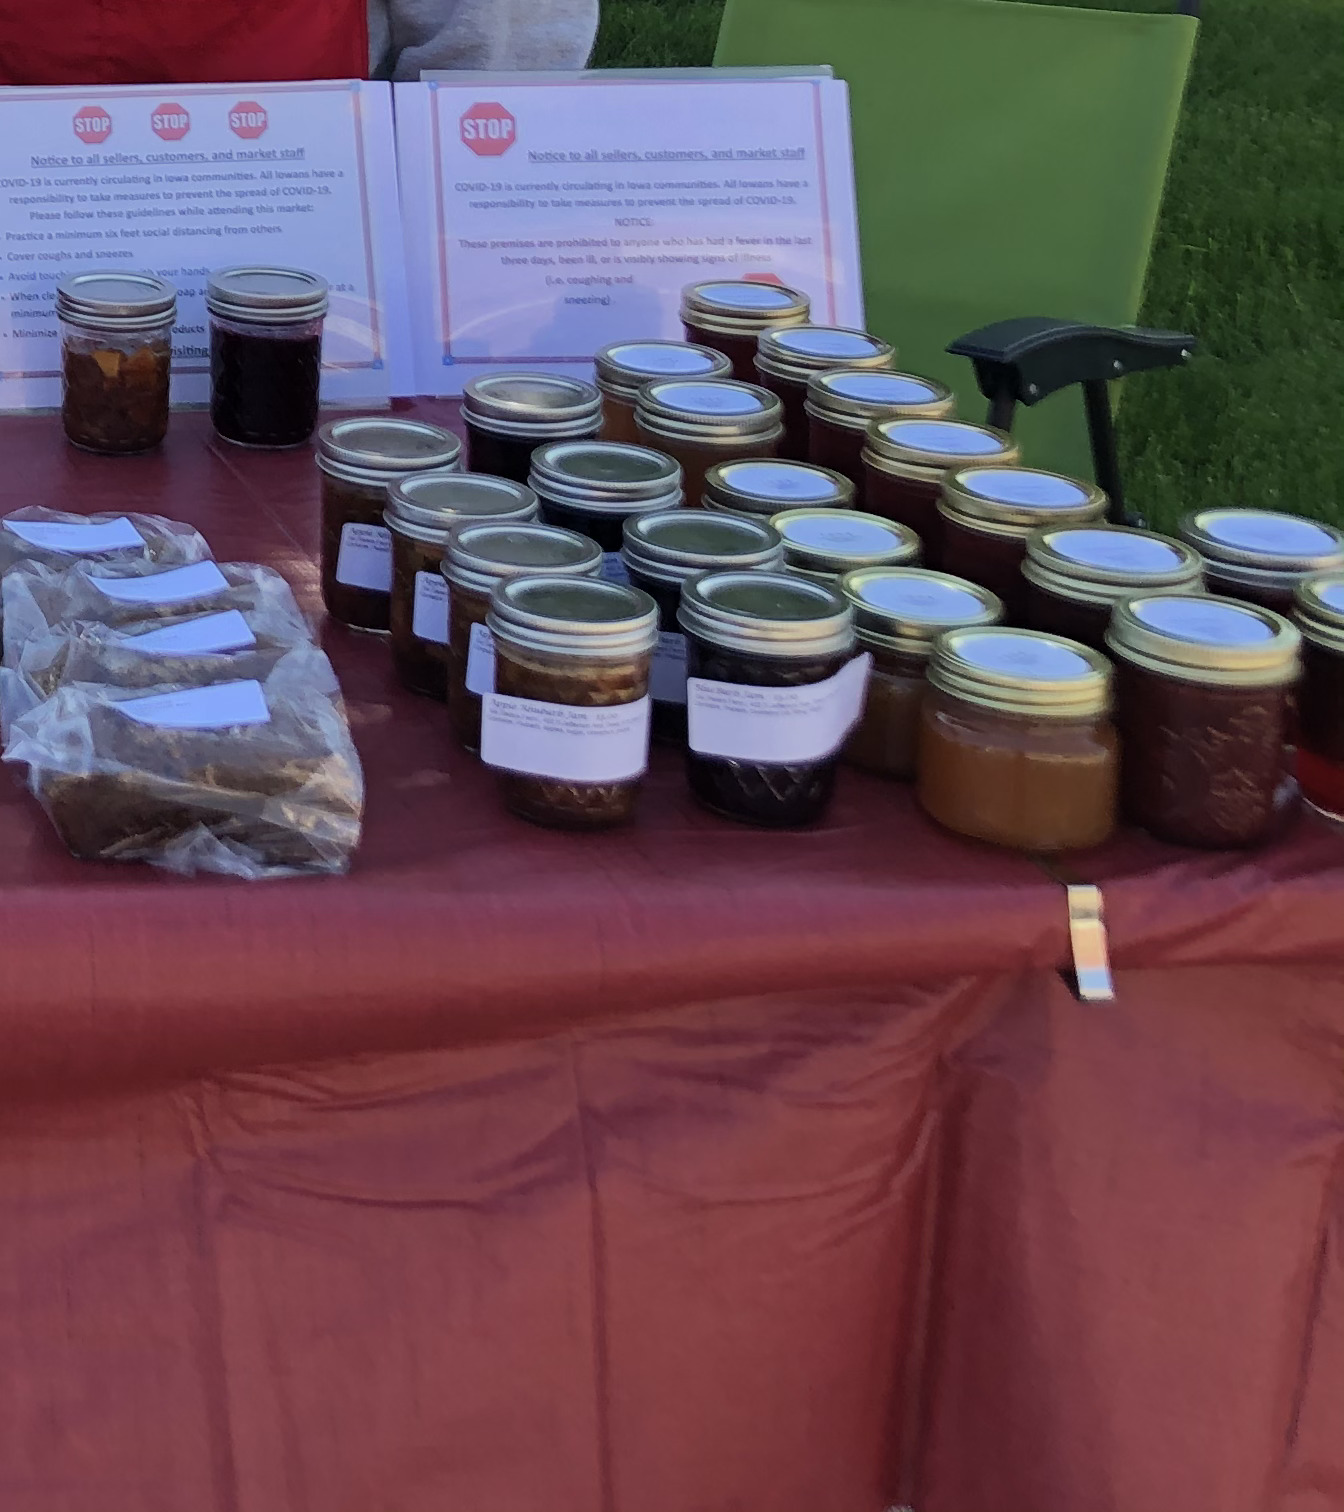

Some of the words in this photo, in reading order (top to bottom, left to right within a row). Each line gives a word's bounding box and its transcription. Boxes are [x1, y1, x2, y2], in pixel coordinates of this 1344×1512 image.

[74, 117, 110, 132] STOP
[154, 114, 188, 129] STOP
[231, 112, 265, 128] STOP
[463, 118, 512, 140] STOP
[31, 155, 68, 166] Notice
[71, 155, 83, 165] to
[87, 154, 100, 164] all
[103, 153, 143, 165] sellers,
[146, 151, 208, 162] customers,
[212, 149, 233, 160] and
[237, 148, 277, 159] market
[280, 147, 304, 158] staff
[528, 150, 565, 161] Notice
[569, 151, 581, 161] to
[585, 149, 598, 160] all
[602, 150, 642, 161] sellers,
[644, 149, 708, 159] customers,
[711, 148, 733, 158] and
[736, 148, 777, 158] market
[780, 147, 805, 158] staff
[44, 178, 52, 186] is
[54, 176, 98, 187] currently
[101, 174, 150, 186] circulating
[154, 173, 162, 183] in
[165, 173, 189, 182] Iowa
[192, 171, 256, 182] communities.
[259, 170, 272, 179] All
[275, 169, 309, 179] Iowans
[312, 168, 335, 178] have
[455, 182, 502, 192] COVID-19
[505, 182, 512, 191] is
[515, 182, 559, 192] currently
[562, 181, 613, 192] circulating
[615, 181, 625, 189] in
[724, 180, 736, 188] All
[777, 178, 799, 188] have
[9, 193, 74, 205] responsibility
[77, 193, 87, 202] to
[90, 192, 111, 201] take
[114, 192, 160, 201] measures
[163, 191, 173, 200] to
[176, 190, 214, 200] prevent
[216, 189, 232, 198] the
[235, 187, 267, 199] spread
[270, 187, 280, 196] of
[283, 186, 332, 196] COVID-19.
[469, 199, 535, 209] responsibility
[538, 199, 547, 208] to
[551, 199, 572, 207] take
[575, 199, 622, 207] measures
[625, 198, 634, 206] to
[638, 197, 676, 207] prevent
[679, 196, 695, 205] the
[698, 196, 731, 206] spread
[734, 196, 743, 205] of
[30, 211, 61, 220] Please
[64, 210, 94, 219] follow
[97, 209, 123, 218] these
[126, 207, 176, 219] guidelines
[179, 205, 204, 216] while
[208, 204, 254, 216] attending
[256, 204, 274, 213] this
[276, 204, 314, 212] market:
[5, 232, 44, 241] Practice
[55, 230, 102, 239] minimum
[105, 229, 118, 238] six
[120, 229, 139, 237] feet
[142, 228, 170, 237] social
[172, 226, 222, 238] distancing
[224, 225, 248, 234] from
[459, 239, 487, 249] These
[491, 239, 535, 249] premises
[556, 238, 607, 248] prohibited
[610, 238, 620, 247] to
[624, 238, 659, 247] anyone
[663, 237, 683, 246] who
[687, 237, 704, 246] has
[707, 237, 724, 245] had
[736, 236, 760, 245] fever
[776, 236, 792, 245] the
[7, 252, 35, 261] Cover
[38, 251, 72, 262] coughs
[75, 250, 93, 259] and
[95, 250, 134, 259] sneezes
[501, 256, 528, 265] three
[559, 255, 583, 264] been
[614, 255, 621, 263] is
[624, 255, 654, 264] visibly
[658, 254, 699, 264] showing
[702, 254, 725, 265] signs
[729, 254, 738, 262] of
[8, 272, 36, 281] Avoid
[157, 268, 179, 278] your
[567, 275, 612, 286] coughing
[614, 274, 633, 284] and
[10, 292, 39, 301] When
[12, 329, 58, 338] Minimize
